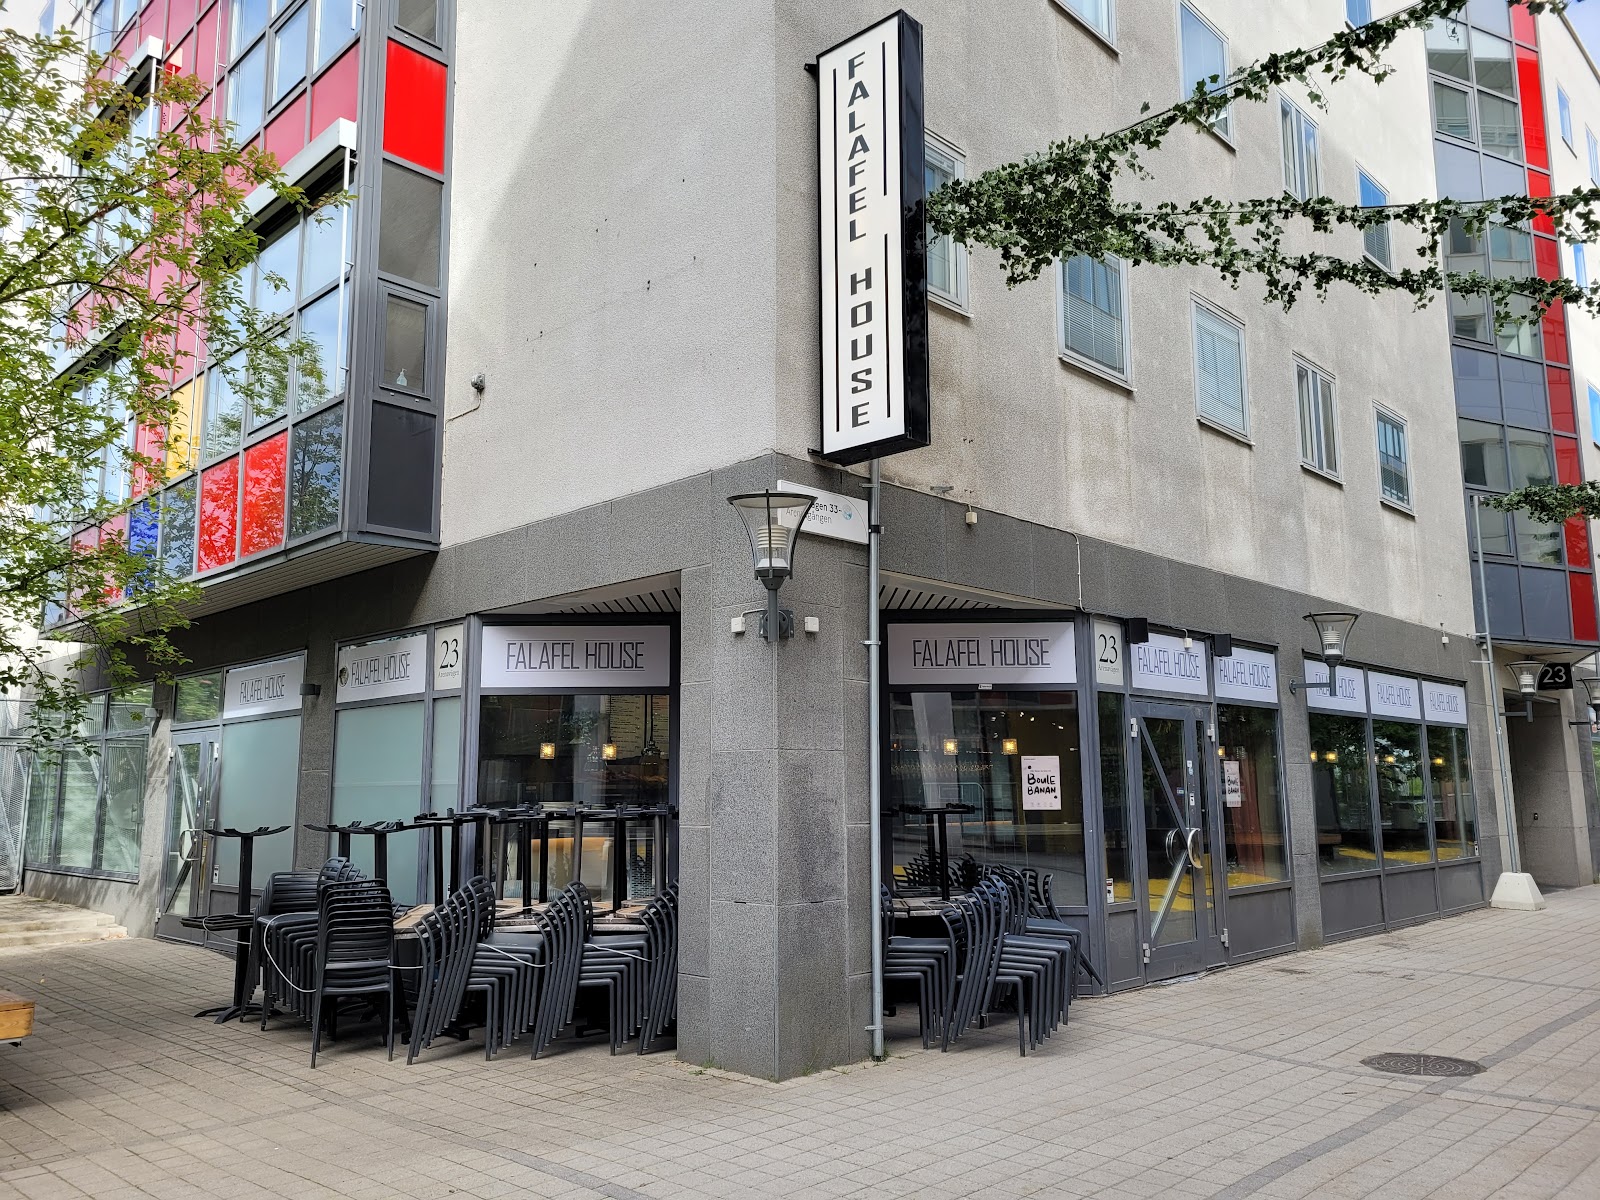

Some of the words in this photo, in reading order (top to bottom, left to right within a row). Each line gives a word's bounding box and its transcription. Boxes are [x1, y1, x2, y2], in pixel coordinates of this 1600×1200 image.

[847, 51, 870, 243] FALAFEL
[850, 267, 872, 429] HOUSE
[439, 638, 459, 669] 23
[506, 642, 580, 670] FALAFEL
[585, 641, 645, 669] HOUSE
[912, 639, 986, 667] FALAFEL
[991, 638, 1051, 666] HOUSE
[1098, 633, 1118, 664] 23
[1137, 646, 1173, 675] FALAFEL
[1173, 651, 1201, 679] HOUSE
[351, 658, 382, 687] FALAFEL
[383, 652, 411, 681] HOUSE
[1219, 658, 1248, 686] FALAFEL
[1248, 663, 1272, 688] HOUSE
[1542, 666, 1567, 683] 23
[240, 679, 263, 703] FALAFEL
[264, 674, 286, 700] HOUSE
[1337, 677, 1357, 699] HOUSE
[1376, 683, 1397, 705] FALAFEL
[1396, 686, 1413, 707] HOUSE
[1430, 692, 1447, 712] FALAFEL
[1445, 695, 1460, 713] HOUSE
[1027, 786, 1056, 796] BANAN
